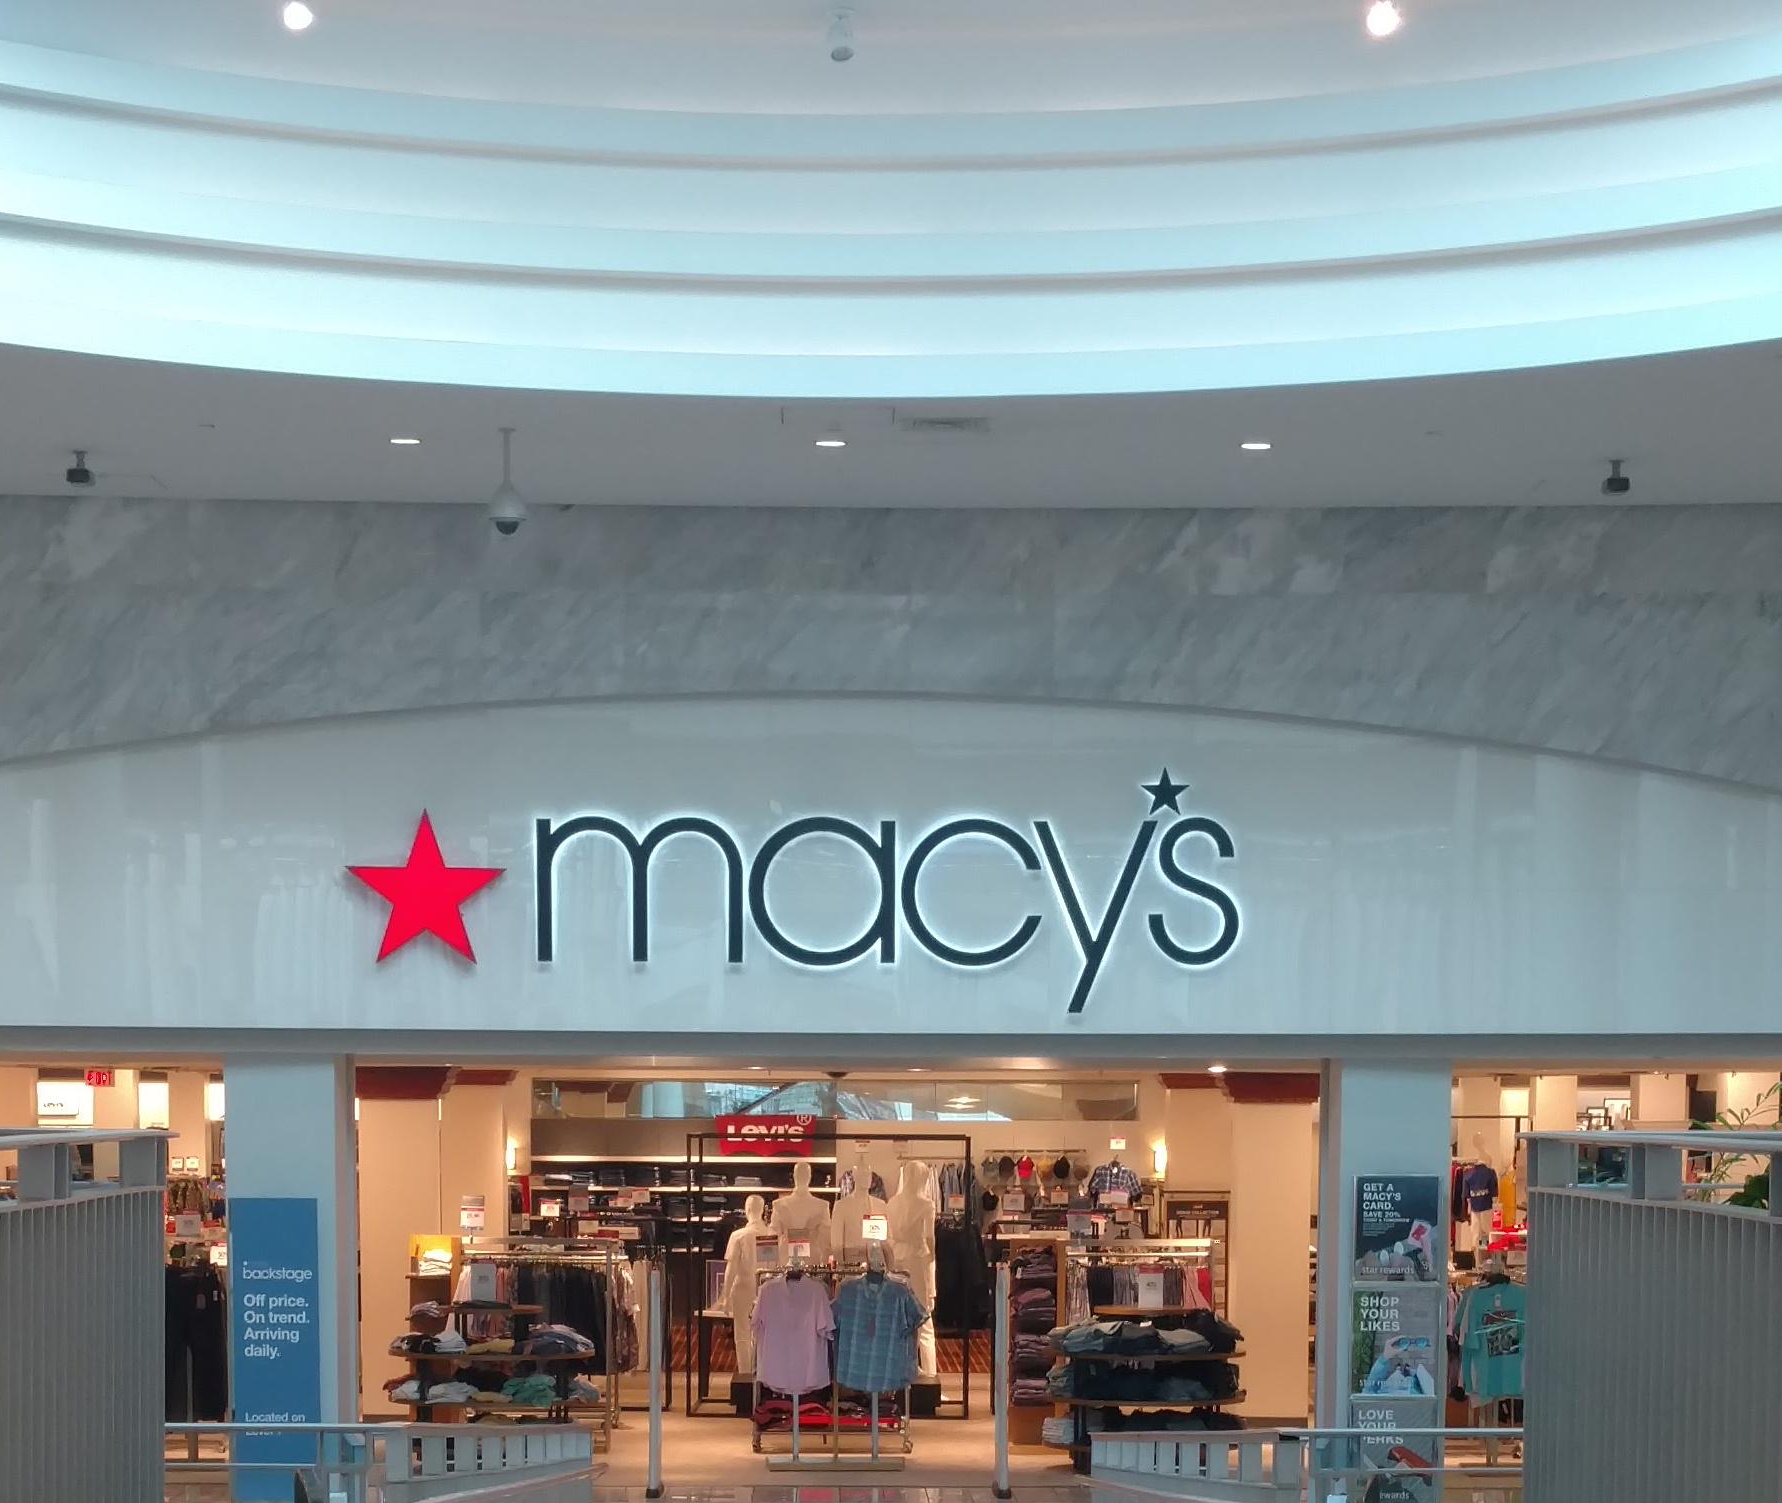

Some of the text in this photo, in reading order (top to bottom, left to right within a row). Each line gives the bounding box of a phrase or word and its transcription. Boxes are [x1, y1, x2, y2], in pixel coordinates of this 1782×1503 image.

[535, 767, 1240, 1014] macy's
[1363, 1183, 1394, 1191] GET A
[1363, 1192, 1401, 1201] MACY'S
[1363, 1210, 1383, 1218] SAVE
[242, 1266, 313, 1283] backstage
[243, 1294, 309, 1310] Off price.
[1360, 1296, 1400, 1307] SHOP
[243, 1311, 311, 1324] On trend.
[1360, 1309, 1399, 1319] YOUR
[1360, 1321, 1401, 1332] LIKES
[244, 1327, 300, 1343] Arriving
[244, 1344, 281, 1360] daily.
[245, 1412, 306, 1423] Located on
[1359, 1410, 1394, 1420] LOVE
[1362, 1434, 1404, 1445] ERKS
